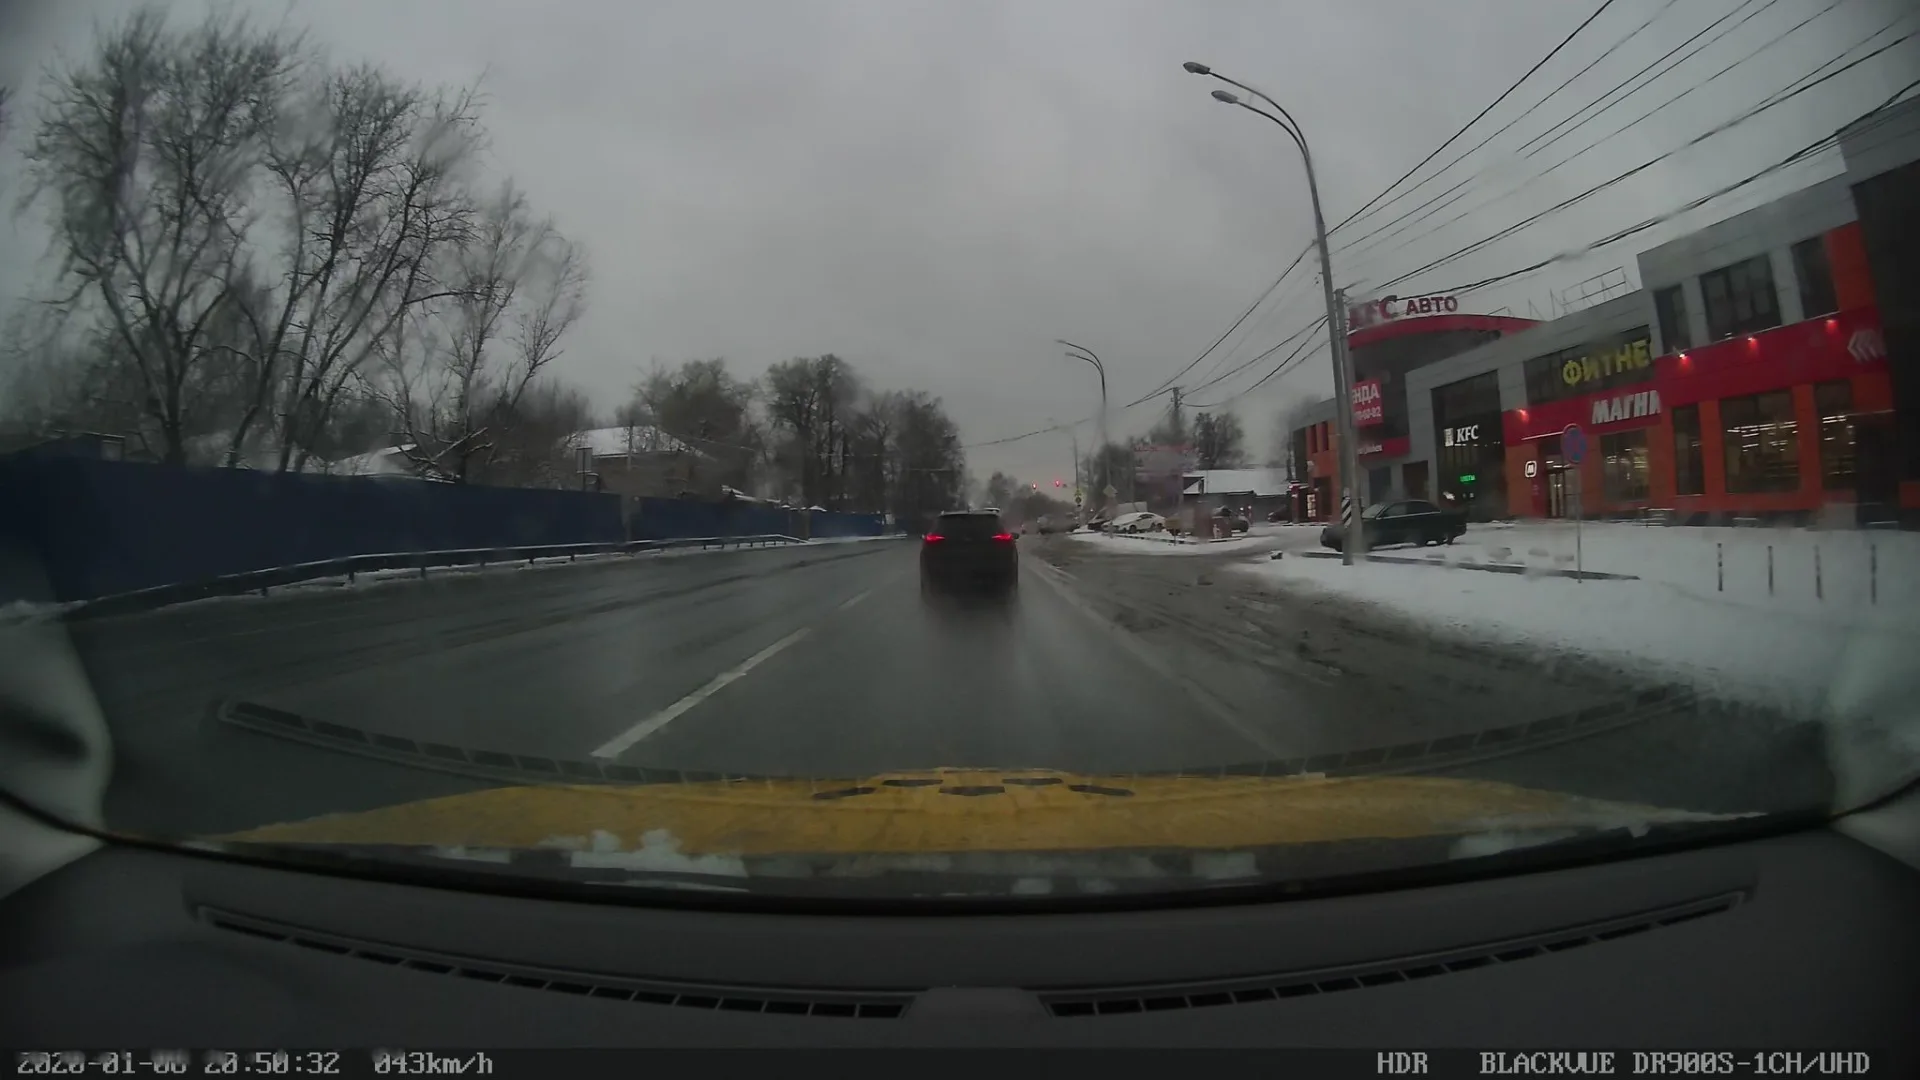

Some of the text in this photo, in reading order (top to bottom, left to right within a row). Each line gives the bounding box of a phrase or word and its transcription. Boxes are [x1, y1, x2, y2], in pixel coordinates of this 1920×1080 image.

[1349, 295, 1397, 330] FC
[1406, 296, 1458, 315] АВТО
[1456, 424, 1479, 443] KFC
